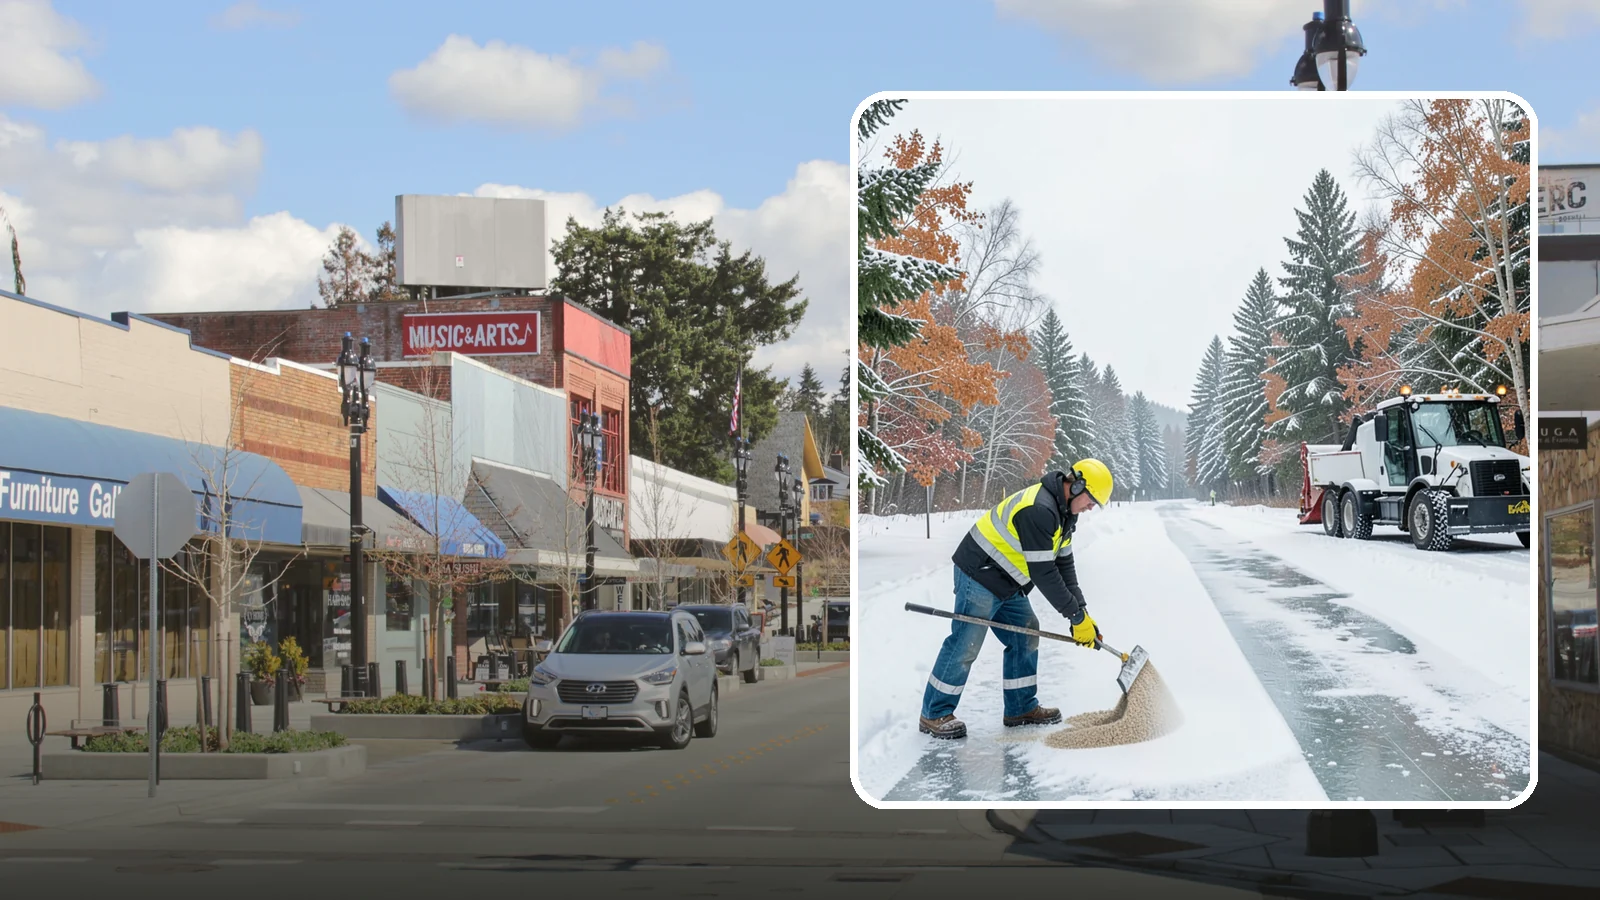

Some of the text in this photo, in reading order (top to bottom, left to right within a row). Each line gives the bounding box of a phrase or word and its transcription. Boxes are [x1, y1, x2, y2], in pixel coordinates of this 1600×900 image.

[409, 322, 520, 350] MUSIC&ARTS
[0, 471, 122, 519] Furniture Gal
